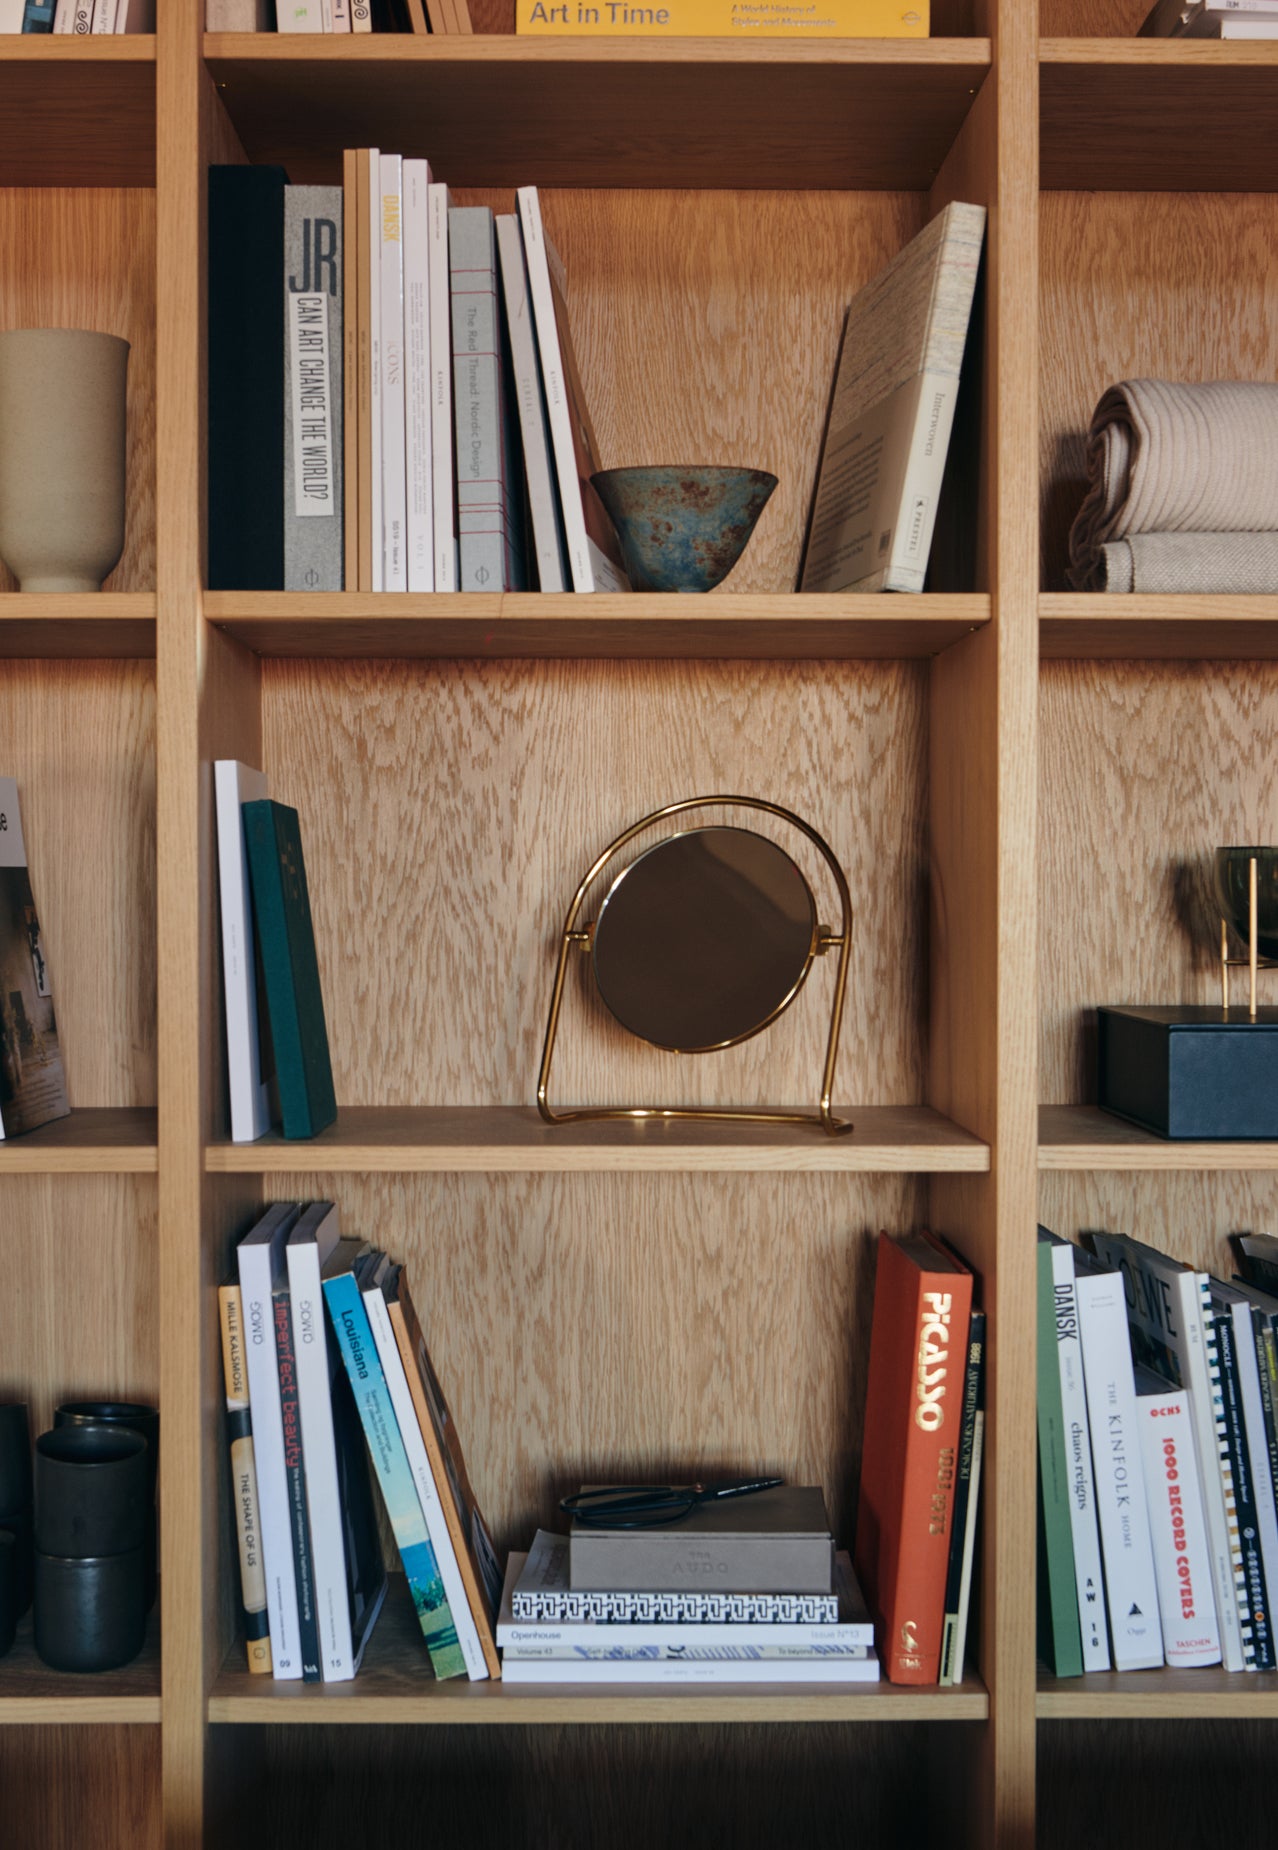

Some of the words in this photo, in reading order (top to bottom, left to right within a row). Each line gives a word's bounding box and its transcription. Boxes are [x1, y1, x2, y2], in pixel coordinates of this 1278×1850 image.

[529, 2, 569, 24] Art
[577, 2, 599, 24] in
[606, 2, 669, 25] Time
[731, 5, 739, 13] A
[741, 5, 769, 13] World
[771, 5, 804, 15] History
[806, 5, 816, 13] of
[731, 17, 759, 28] Styles
[763, 18, 780, 26] and
[782, 17, 837, 27] Movements
[383, 194, 400, 242] DANSK
[289, 218, 337, 297] JR
[297, 297, 323, 324] CAN
[467, 306, 477, 327] The
[298, 328, 324, 354] ART
[467, 329, 478, 352] Red
[299, 359, 326, 411] CHANGE
[301, 416, 327, 440] THE
[470, 401, 482, 438] Nordic
[924, 391, 947, 457] Interwoven
[302, 445, 329, 501] WORLD?
[470, 440, 483, 479] Design
[908, 511, 922, 552] PRESTEL
[392, 546, 400, 565] Issue
[226, 1301, 240, 1332] MILLE
[1054, 1284, 1077, 1343] DANSK
[274, 1301, 296, 1395] imperfect
[340, 1309, 370, 1380] Louisiana
[915, 1291, 952, 1432] PICASSO
[1219, 1324, 1233, 1368] MONOCLE
[229, 1335, 243, 1393] KALSMOSE
[1107, 1381, 1117, 1406] THE
[282, 1401, 302, 1468] beauty
[1071, 1422, 1086, 1463] chaos
[1108, 1414, 1131, 1508] KINFOLK
[1162, 1437, 1179, 1481] 1000
[240, 1473, 251, 1494] THE
[1074, 1465, 1090, 1511] reigns
[242, 1496, 254, 1532] SHAPE
[1121, 1514, 1133, 1549] HOME
[1167, 1485, 1187, 1552] RECORD
[245, 1535, 256, 1550] OF
[247, 1553, 258, 1567] US
[1176, 1555, 1196, 1620] COVERS
[511, 1630, 561, 1641] Openhouse
[516, 1647, 542, 1656] Volume
[811, 1630, 835, 1639] Issue
[1175, 1638, 1212, 1649] TASCHEN
